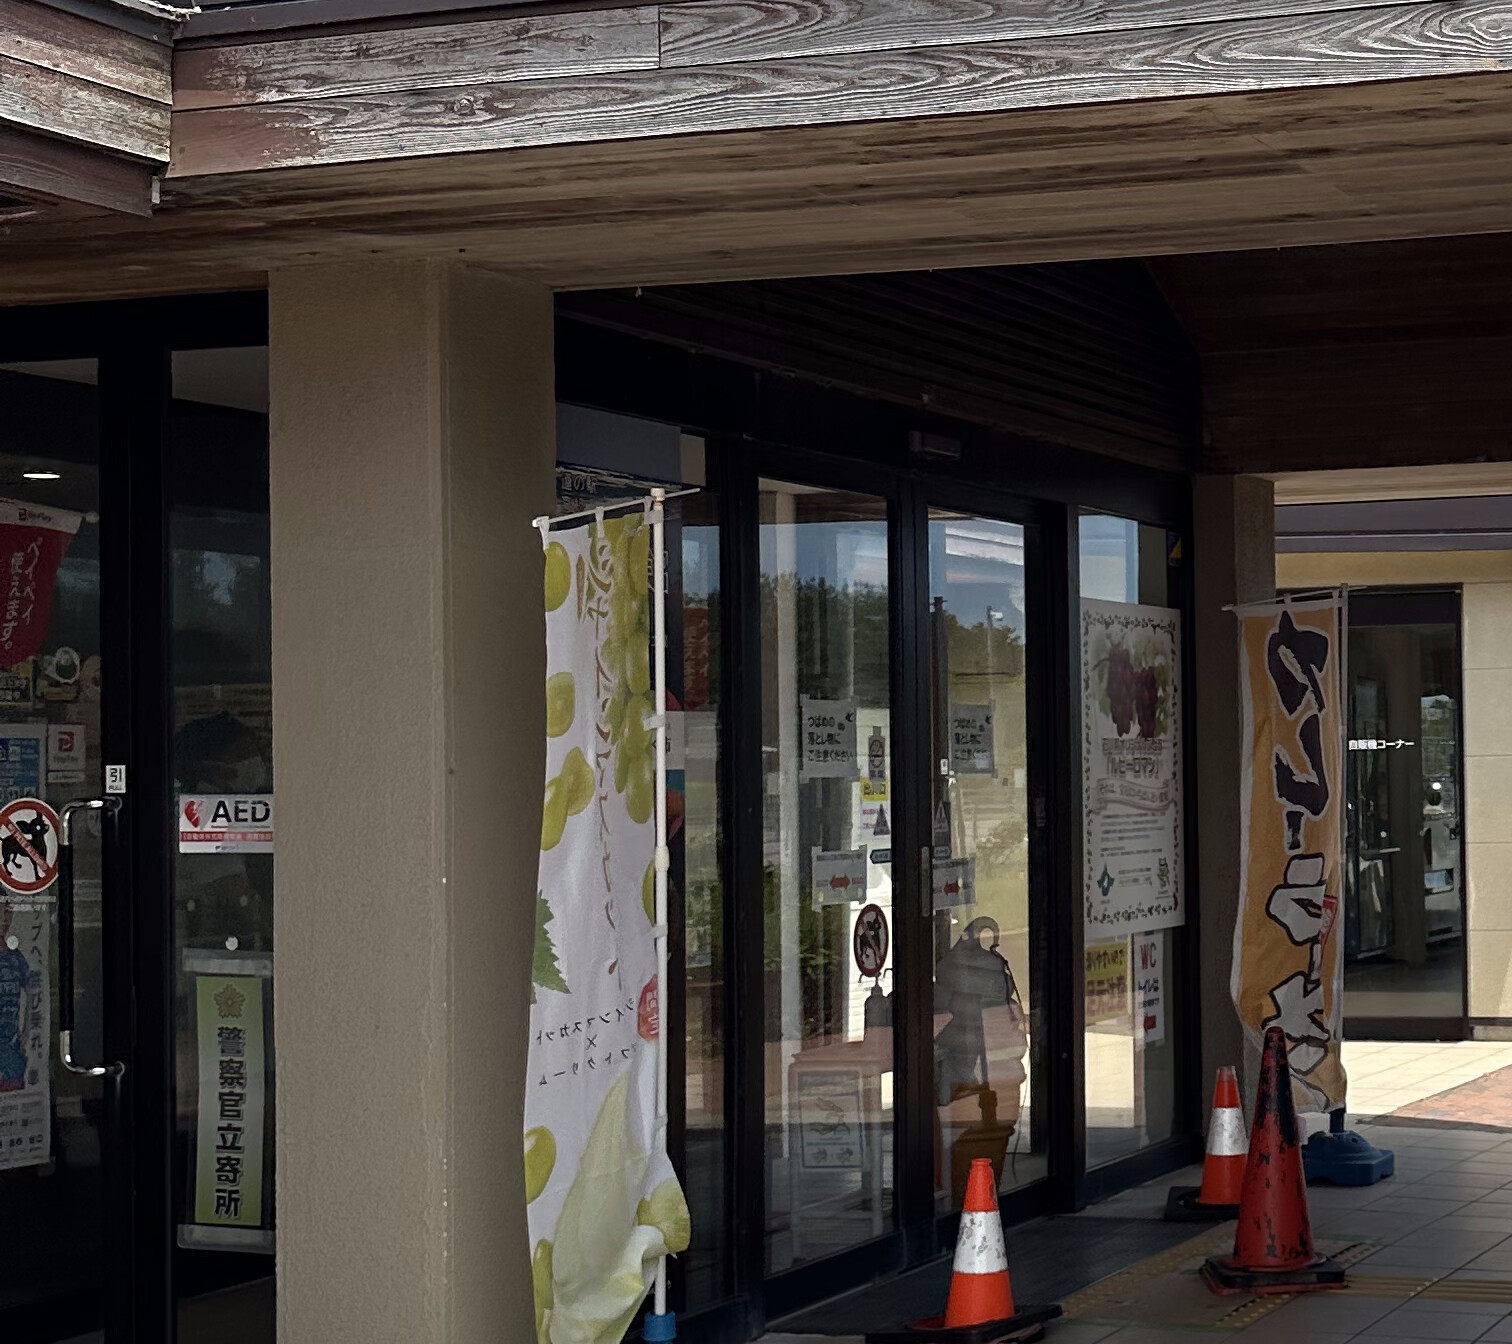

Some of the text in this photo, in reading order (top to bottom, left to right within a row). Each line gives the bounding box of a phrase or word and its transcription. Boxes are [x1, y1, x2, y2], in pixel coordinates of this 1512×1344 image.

[21, 536, 43, 626] ペイペイ
[0, 551, 25, 650] 使えます。
[808, 716, 836, 728] つばめの
[808, 731, 842, 745] 落とし物に
[1348, 739, 1415, 751] 自販機コーナー
[109, 767, 123, 784] 引
[211, 799, 271, 824] AED
[1139, 942, 1157, 970] WC
[214, 1025, 248, 1219] 警察官立寄所
